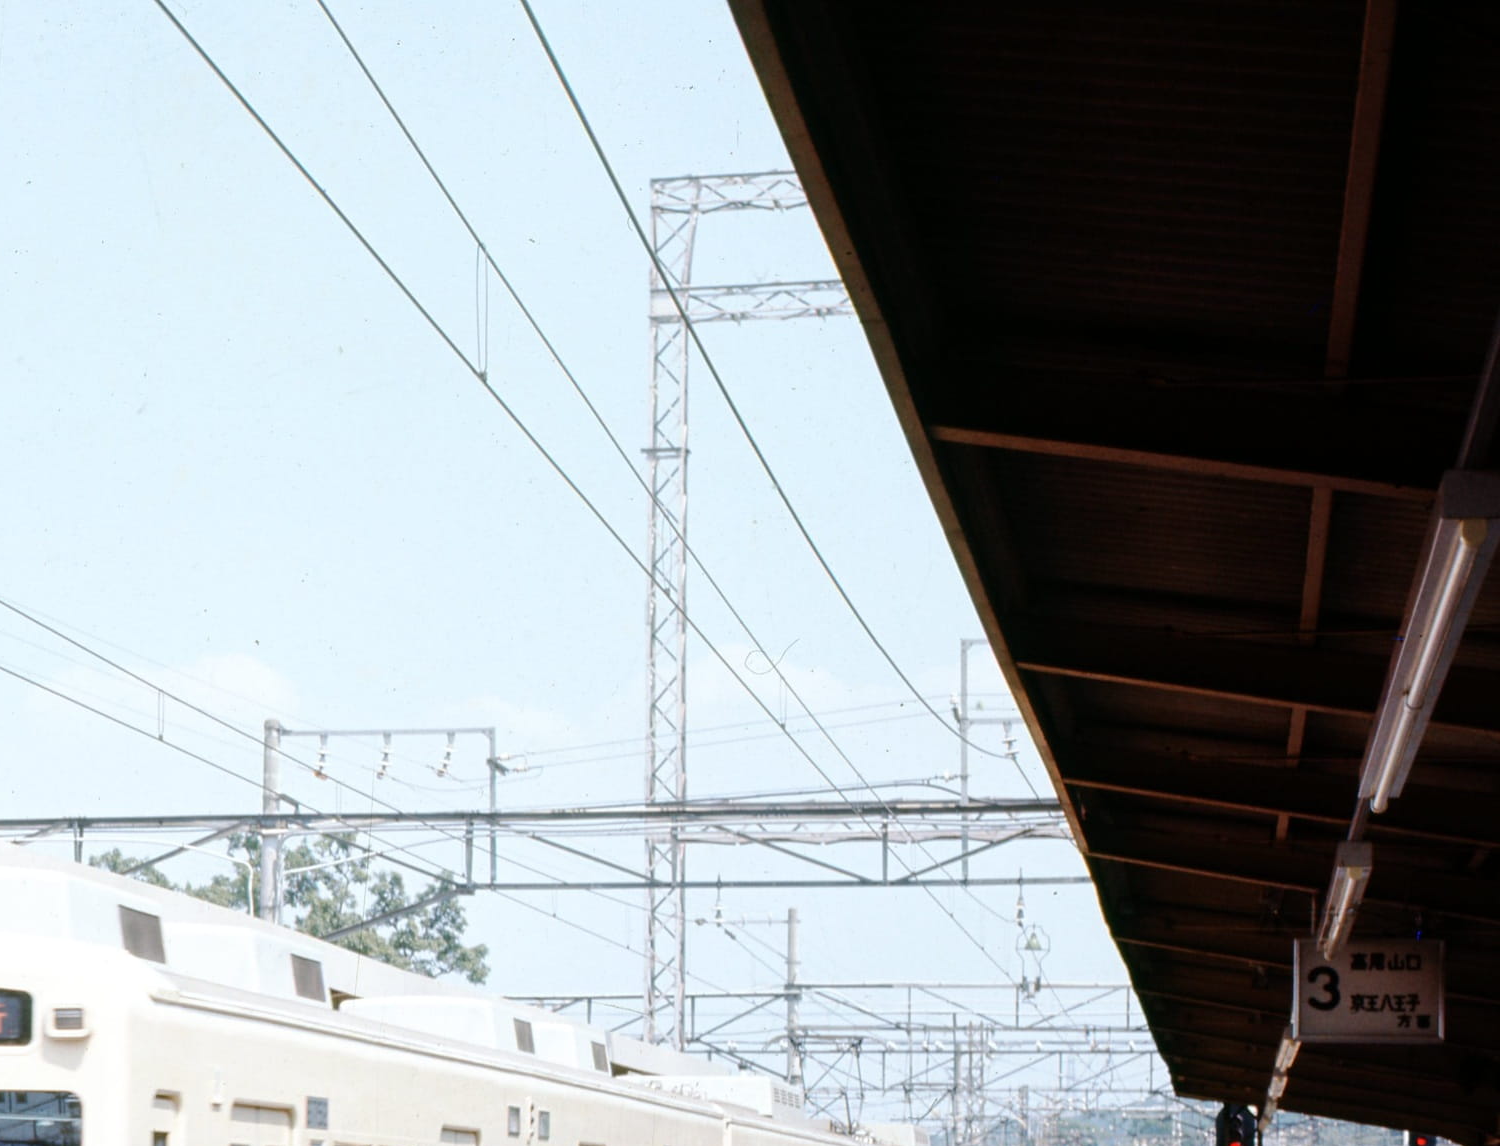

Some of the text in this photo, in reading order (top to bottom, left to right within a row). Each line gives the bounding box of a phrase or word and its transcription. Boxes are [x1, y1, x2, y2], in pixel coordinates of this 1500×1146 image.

[1350, 952, 1422, 971] 高尾山口
[1307, 965, 1341, 1011] 3
[1350, 993, 1421, 1013] 京王八王子
[1397, 1014, 1431, 1029] 方面
